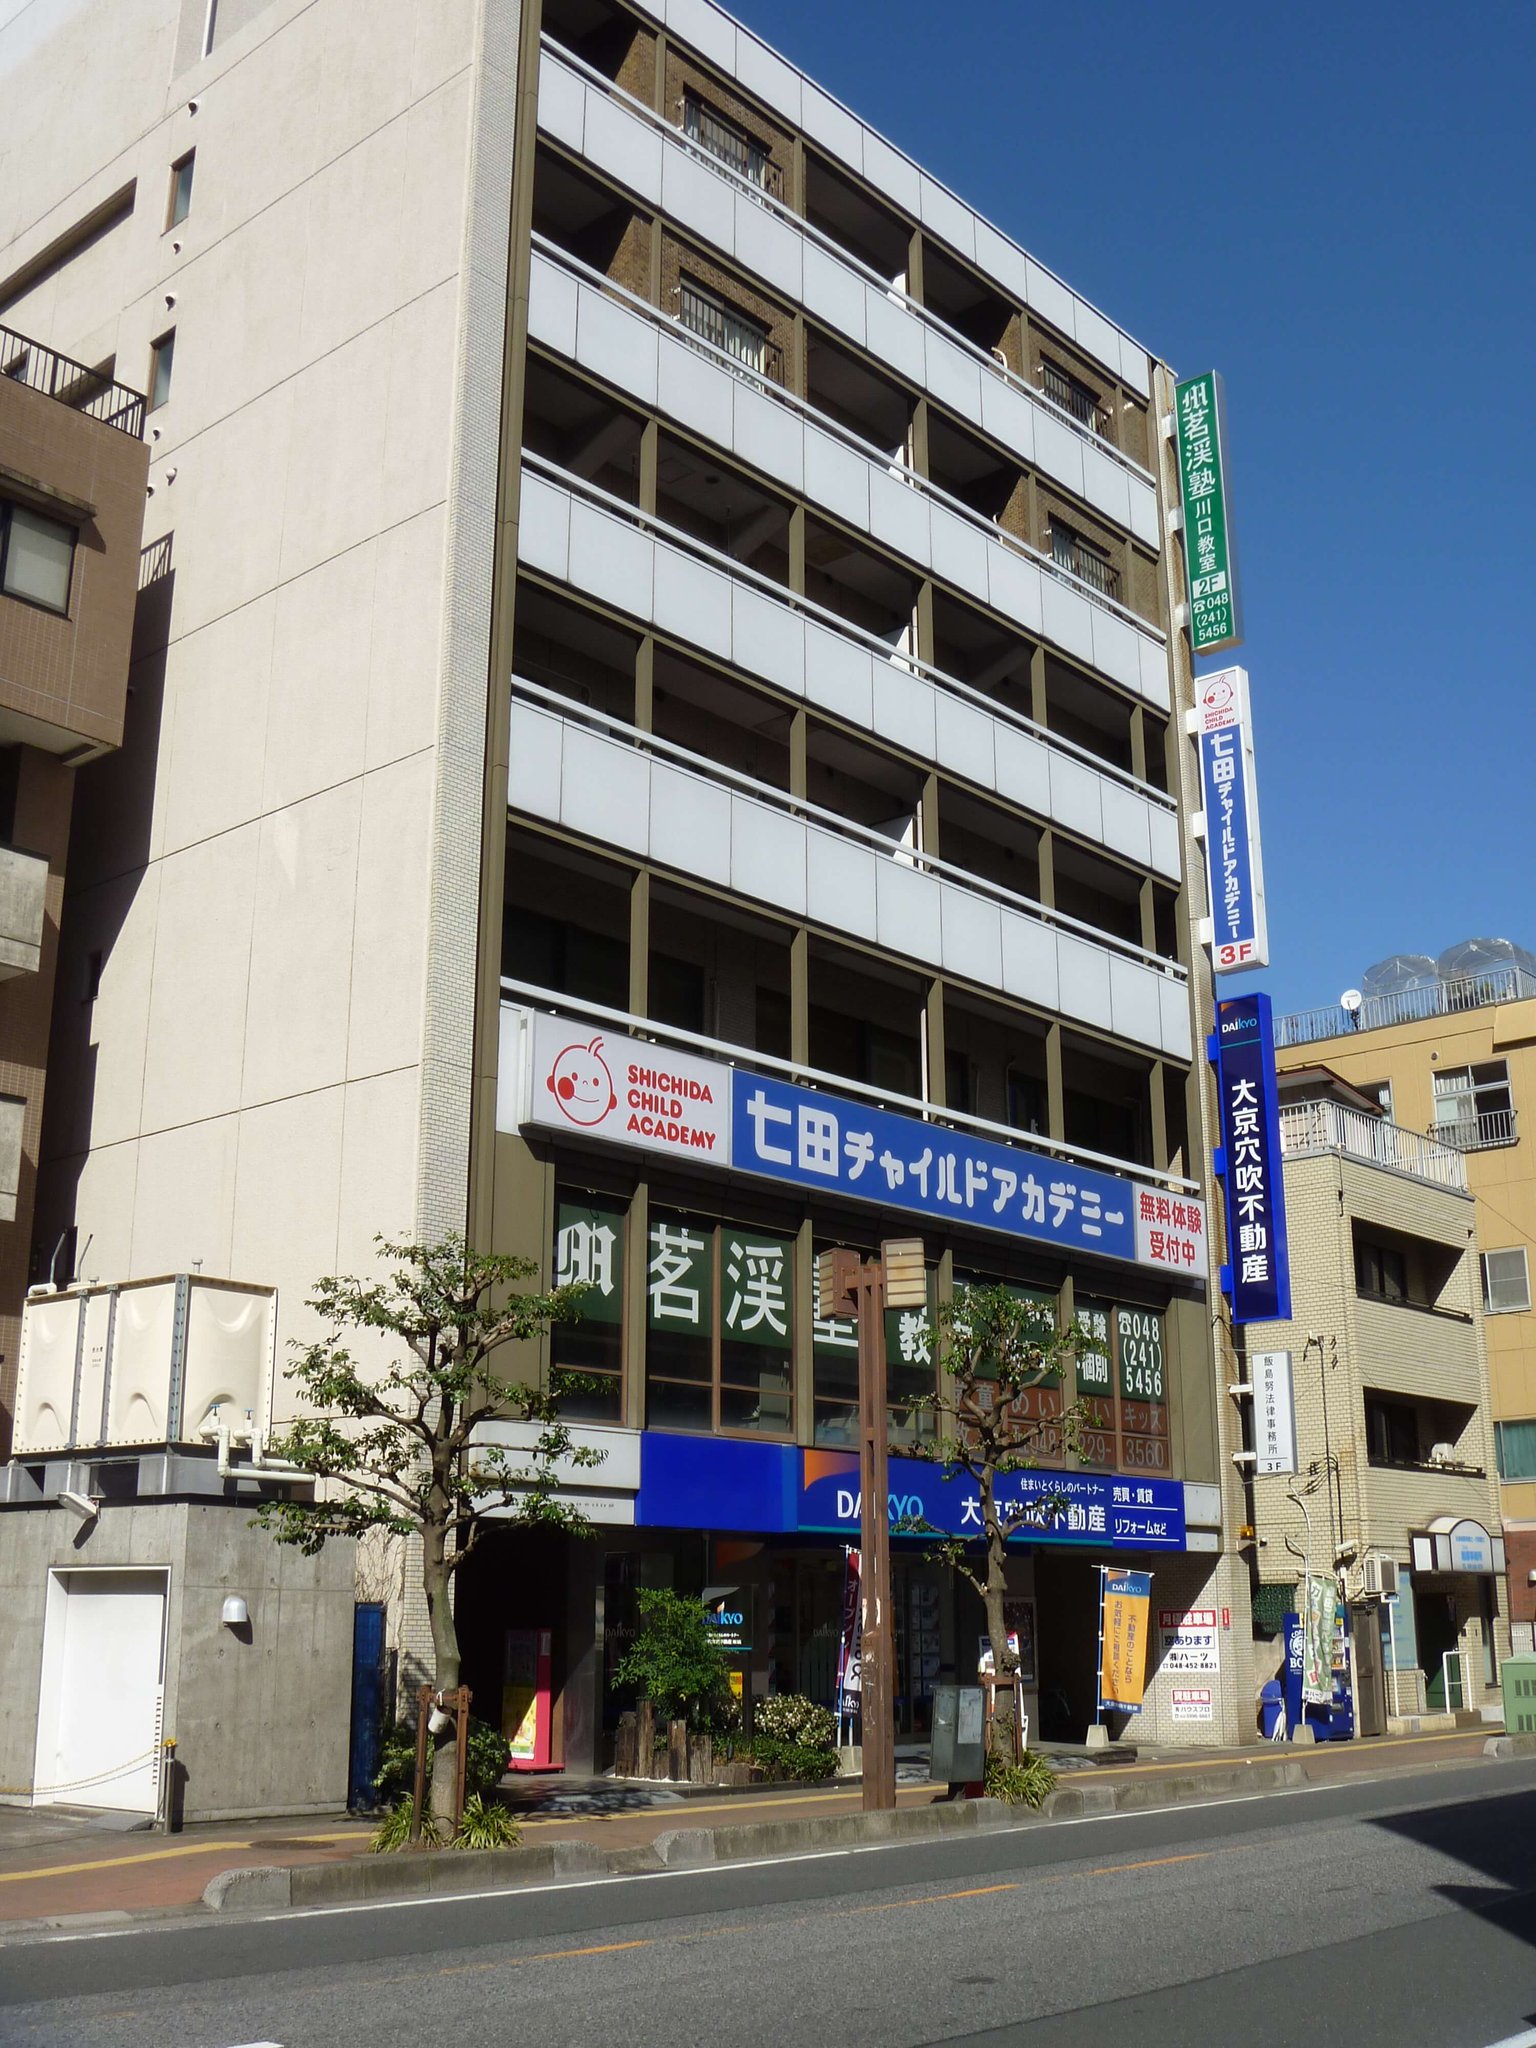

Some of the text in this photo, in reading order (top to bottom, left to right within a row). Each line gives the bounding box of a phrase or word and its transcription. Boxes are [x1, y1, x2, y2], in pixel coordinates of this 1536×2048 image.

[1183, 409, 1215, 501] 茗渓塾
[1195, 498, 1217, 574] 川口教室
[1198, 574, 1219, 595] 2F
[1207, 593, 1228, 610] 048
[1196, 608, 1227, 627] (241)
[1198, 623, 1227, 641] 5456
[1204, 706, 1233, 719] SHICHIDA
[1204, 715, 1224, 725] CHILD
[1205, 717, 1235, 730] ACADEMY
[1220, 943, 1252, 965] 3F
[627, 1064, 713, 1104] SHICHIDA
[627, 1089, 683, 1119] CHILD
[627, 1113, 716, 1151] ACADEMY
[1231, 1078, 1269, 1285] 大京穴吹不動産
[1139, 1191, 1203, 1235] 無料体験
[1149, 1230, 1196, 1268] 受付中
[1133, 1313, 1160, 1343] 048
[1123, 1337, 1162, 1372] (241)
[1126, 1367, 1162, 1397] 5456
[1264, 1354, 1279, 1455] 飯島努法律事務所
[1266, 1461, 1282, 1473] 3F
[1020, 1477, 1105, 1496] 住まいとくらしのパートナー
[1115, 1518, 1167, 1536] リフォームなど
